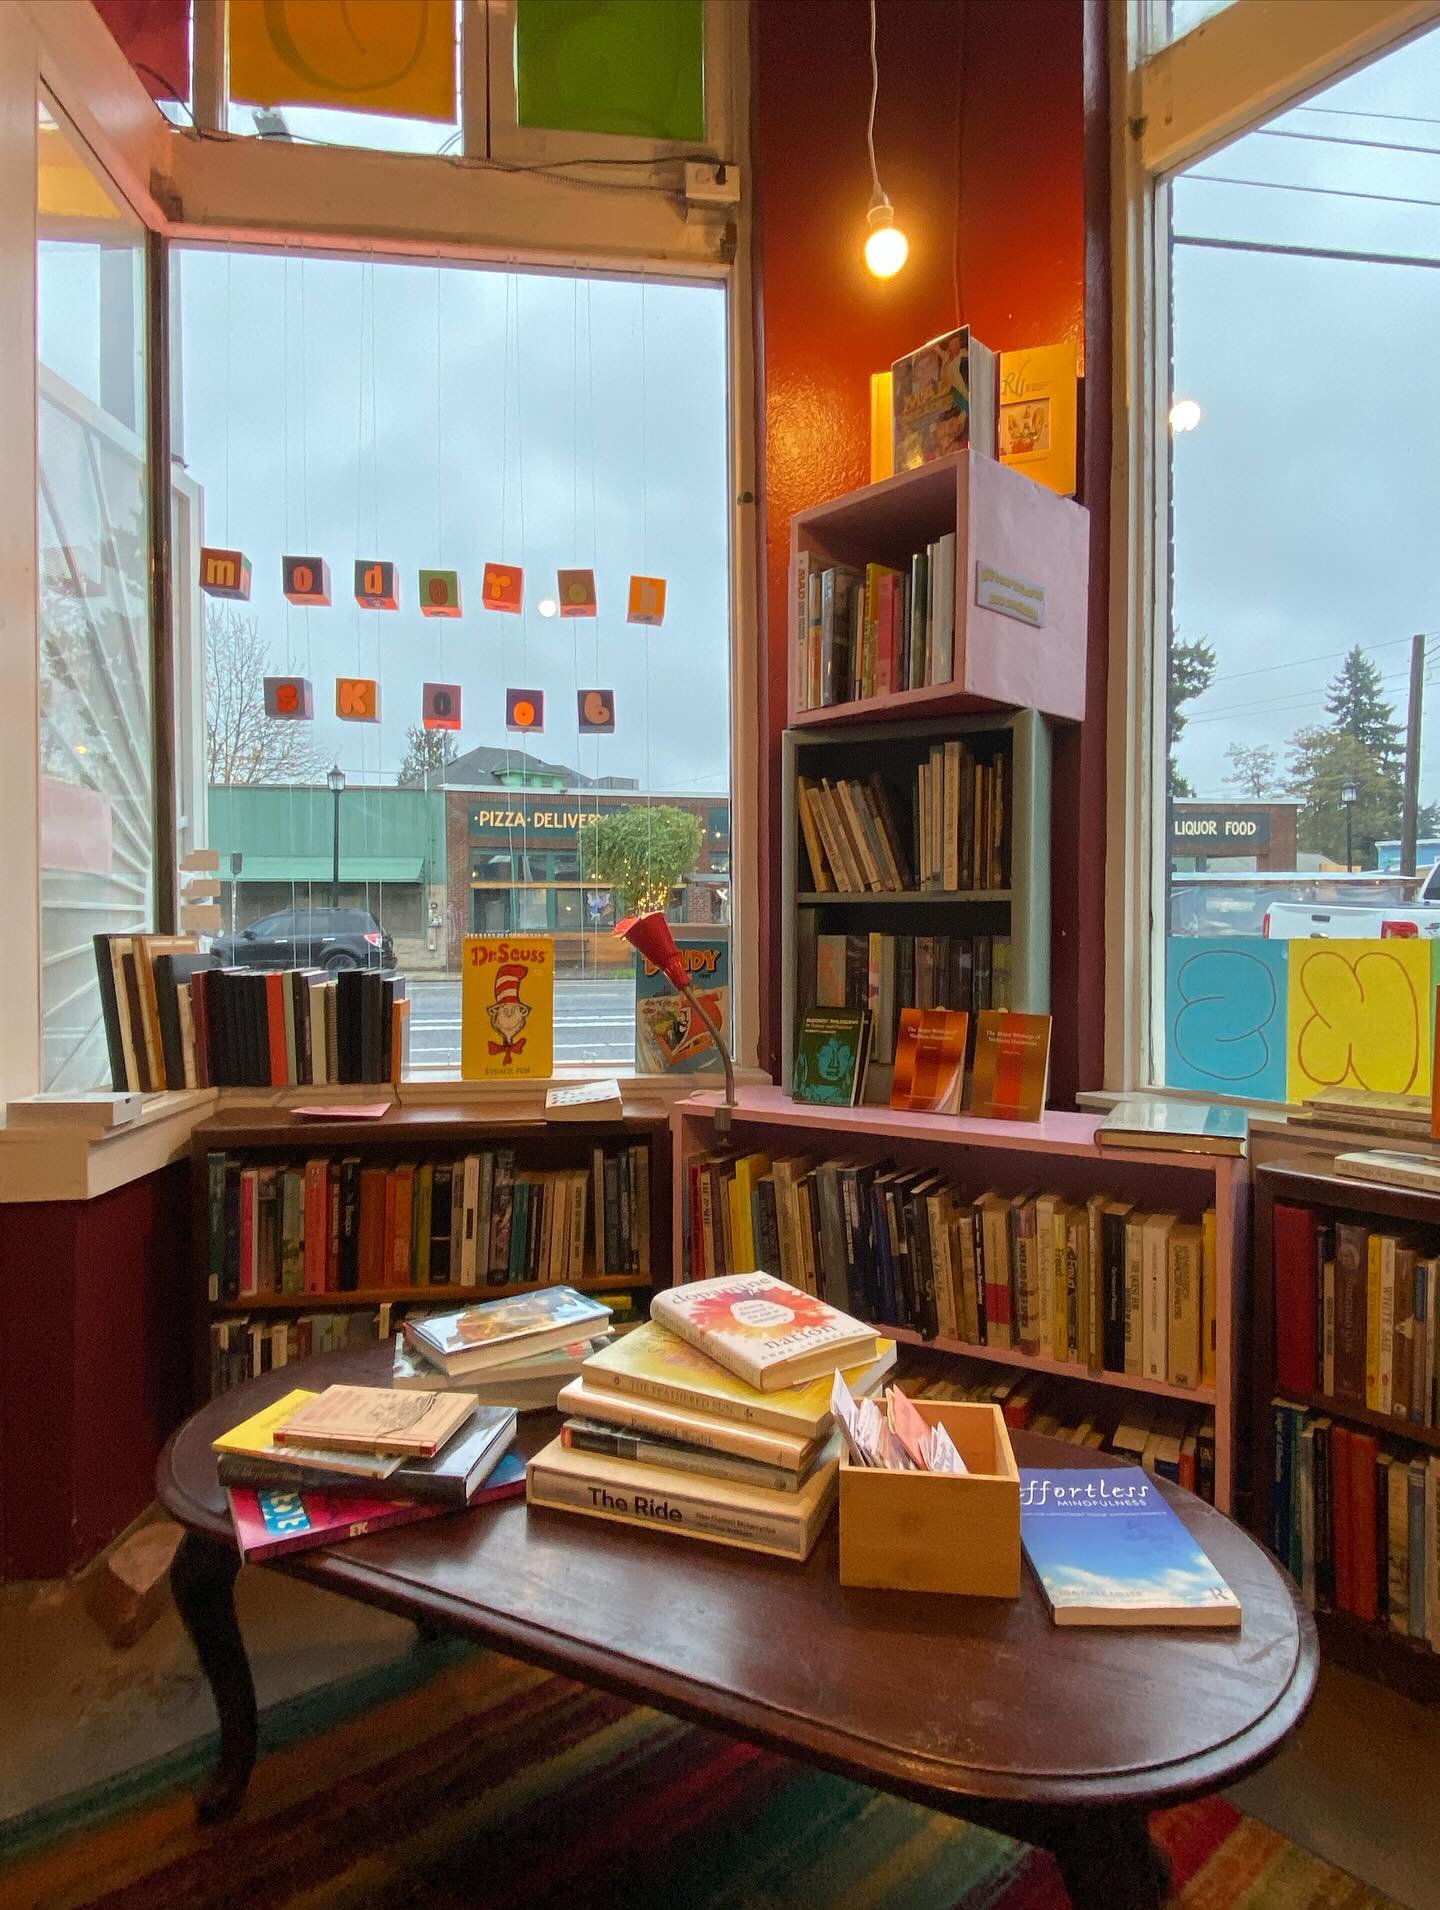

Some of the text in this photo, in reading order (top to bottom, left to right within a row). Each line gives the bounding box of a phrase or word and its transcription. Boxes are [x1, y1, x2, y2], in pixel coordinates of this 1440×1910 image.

[479, 810, 609, 829] PIZZA DELIVER
[1174, 820, 1257, 836] LIQUOR FOOD
[672, 1275, 773, 1305] dopamine
[764, 1324, 838, 1349] nation
[587, 1486, 683, 1522] The Ride
[1057, 1499, 1147, 1507] MINDFULNESS
